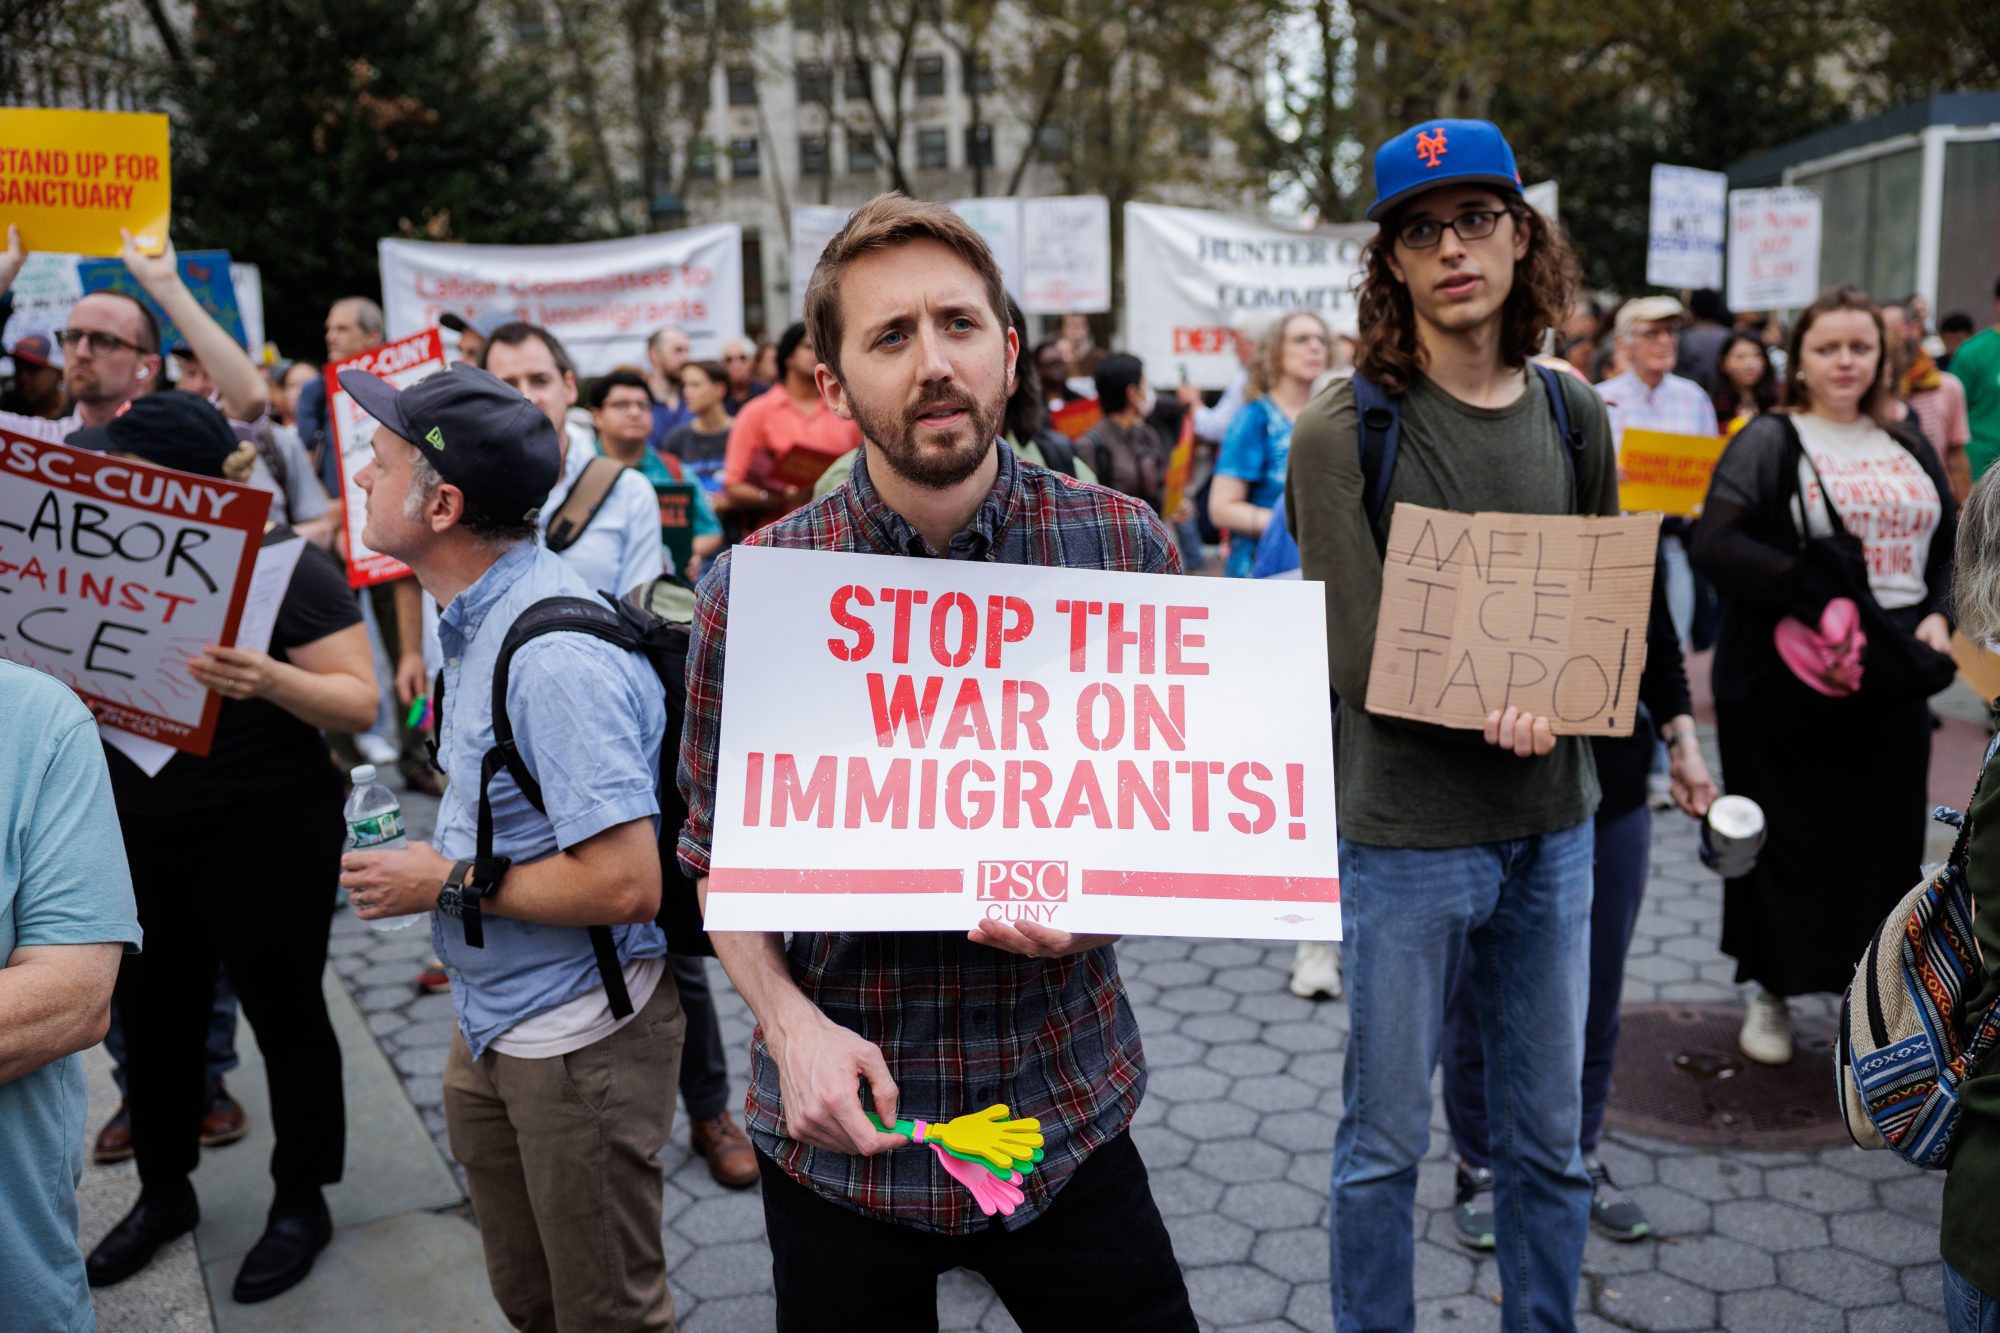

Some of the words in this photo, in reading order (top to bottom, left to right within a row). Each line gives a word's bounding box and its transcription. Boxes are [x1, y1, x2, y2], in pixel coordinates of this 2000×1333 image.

[77, 151, 107, 180] UP
[115, 154, 160, 182] FOR
[414, 273, 497, 299] Labor
[508, 268, 673, 297] Committee
[682, 264, 711, 288] to
[540, 300, 706, 329] Immigrants
[1406, 518, 1625, 592] MELT
[827, 584, 1035, 669] STOP
[1056, 599, 1210, 676] THE
[1396, 627, 1630, 728] TAPO!
[866, 672, 1050, 751] WAR
[1076, 682, 1186, 752] ON
[743, 751, 1307, 841] IMMIGRANTS!
[979, 861, 1066, 901] PSC
[985, 903, 1059, 923] CUNY
